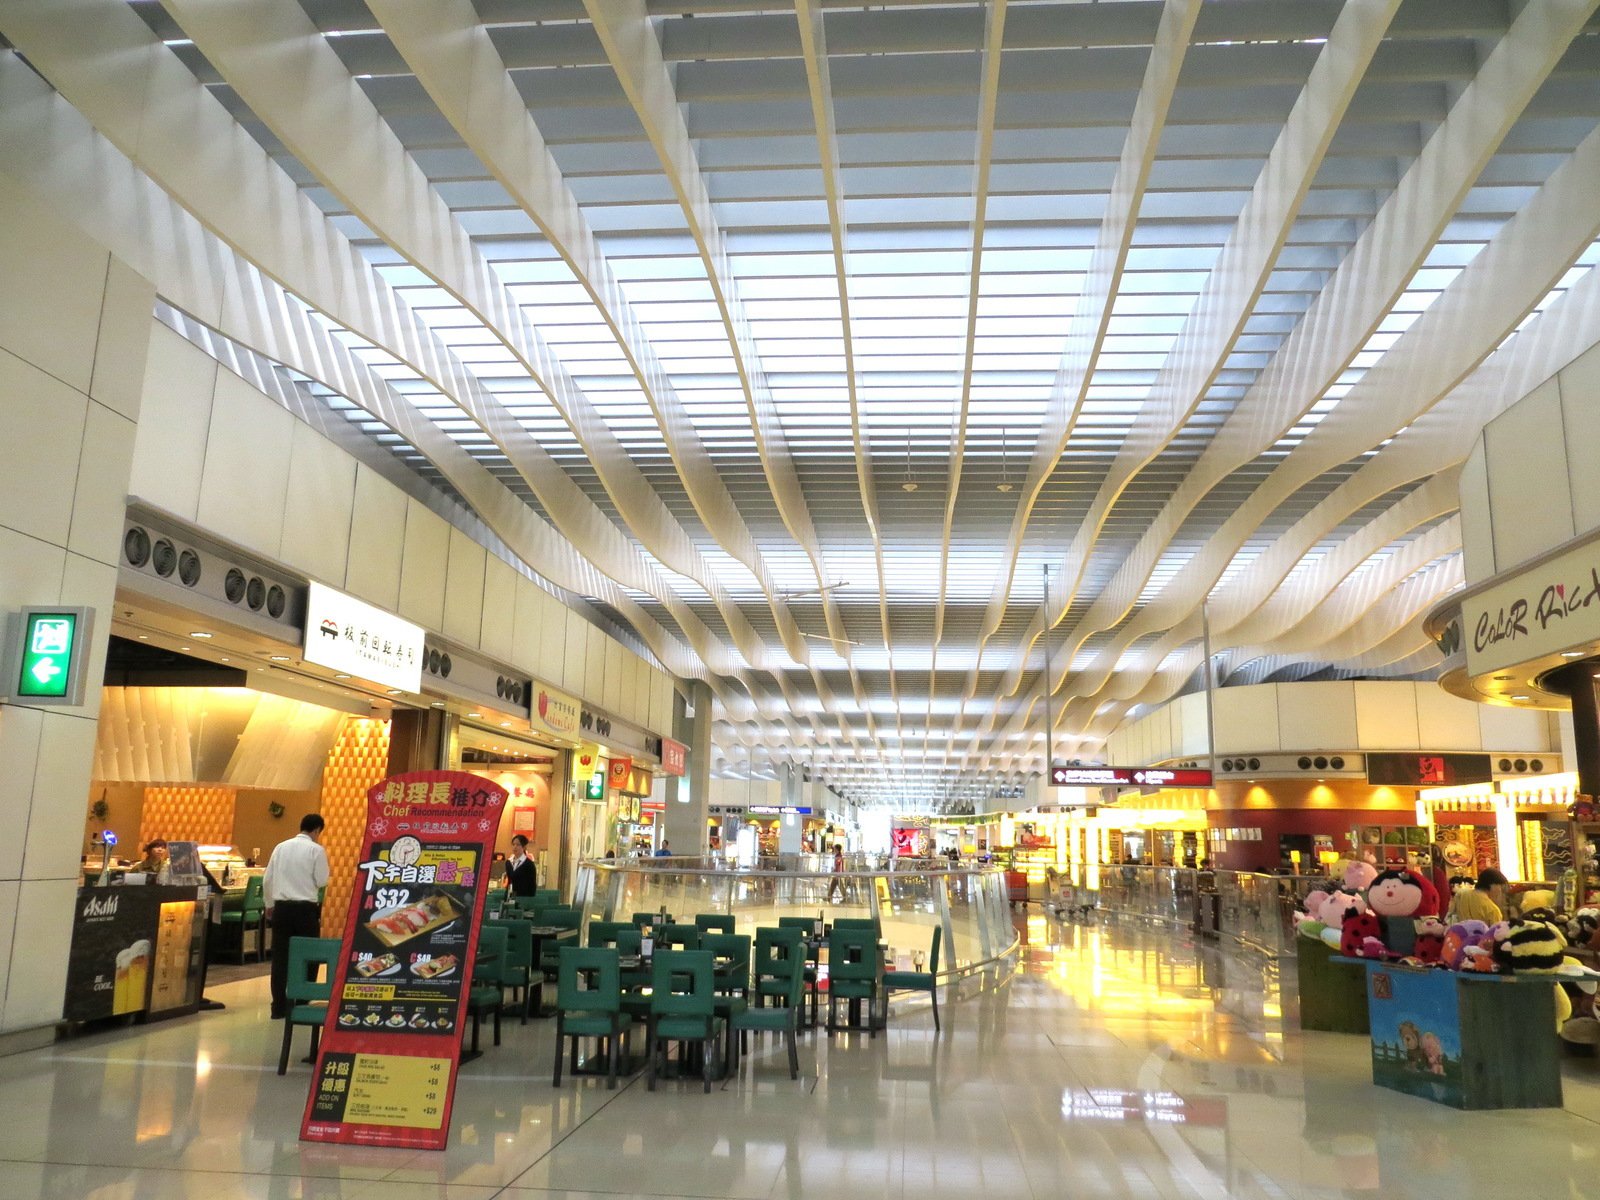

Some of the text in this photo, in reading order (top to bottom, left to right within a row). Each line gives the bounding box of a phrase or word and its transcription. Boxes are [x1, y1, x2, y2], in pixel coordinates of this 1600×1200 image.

[383, 804, 484, 818] Chef Recommendation
[83, 895, 119, 917] Asahi
[375, 887, 410, 910] $32
